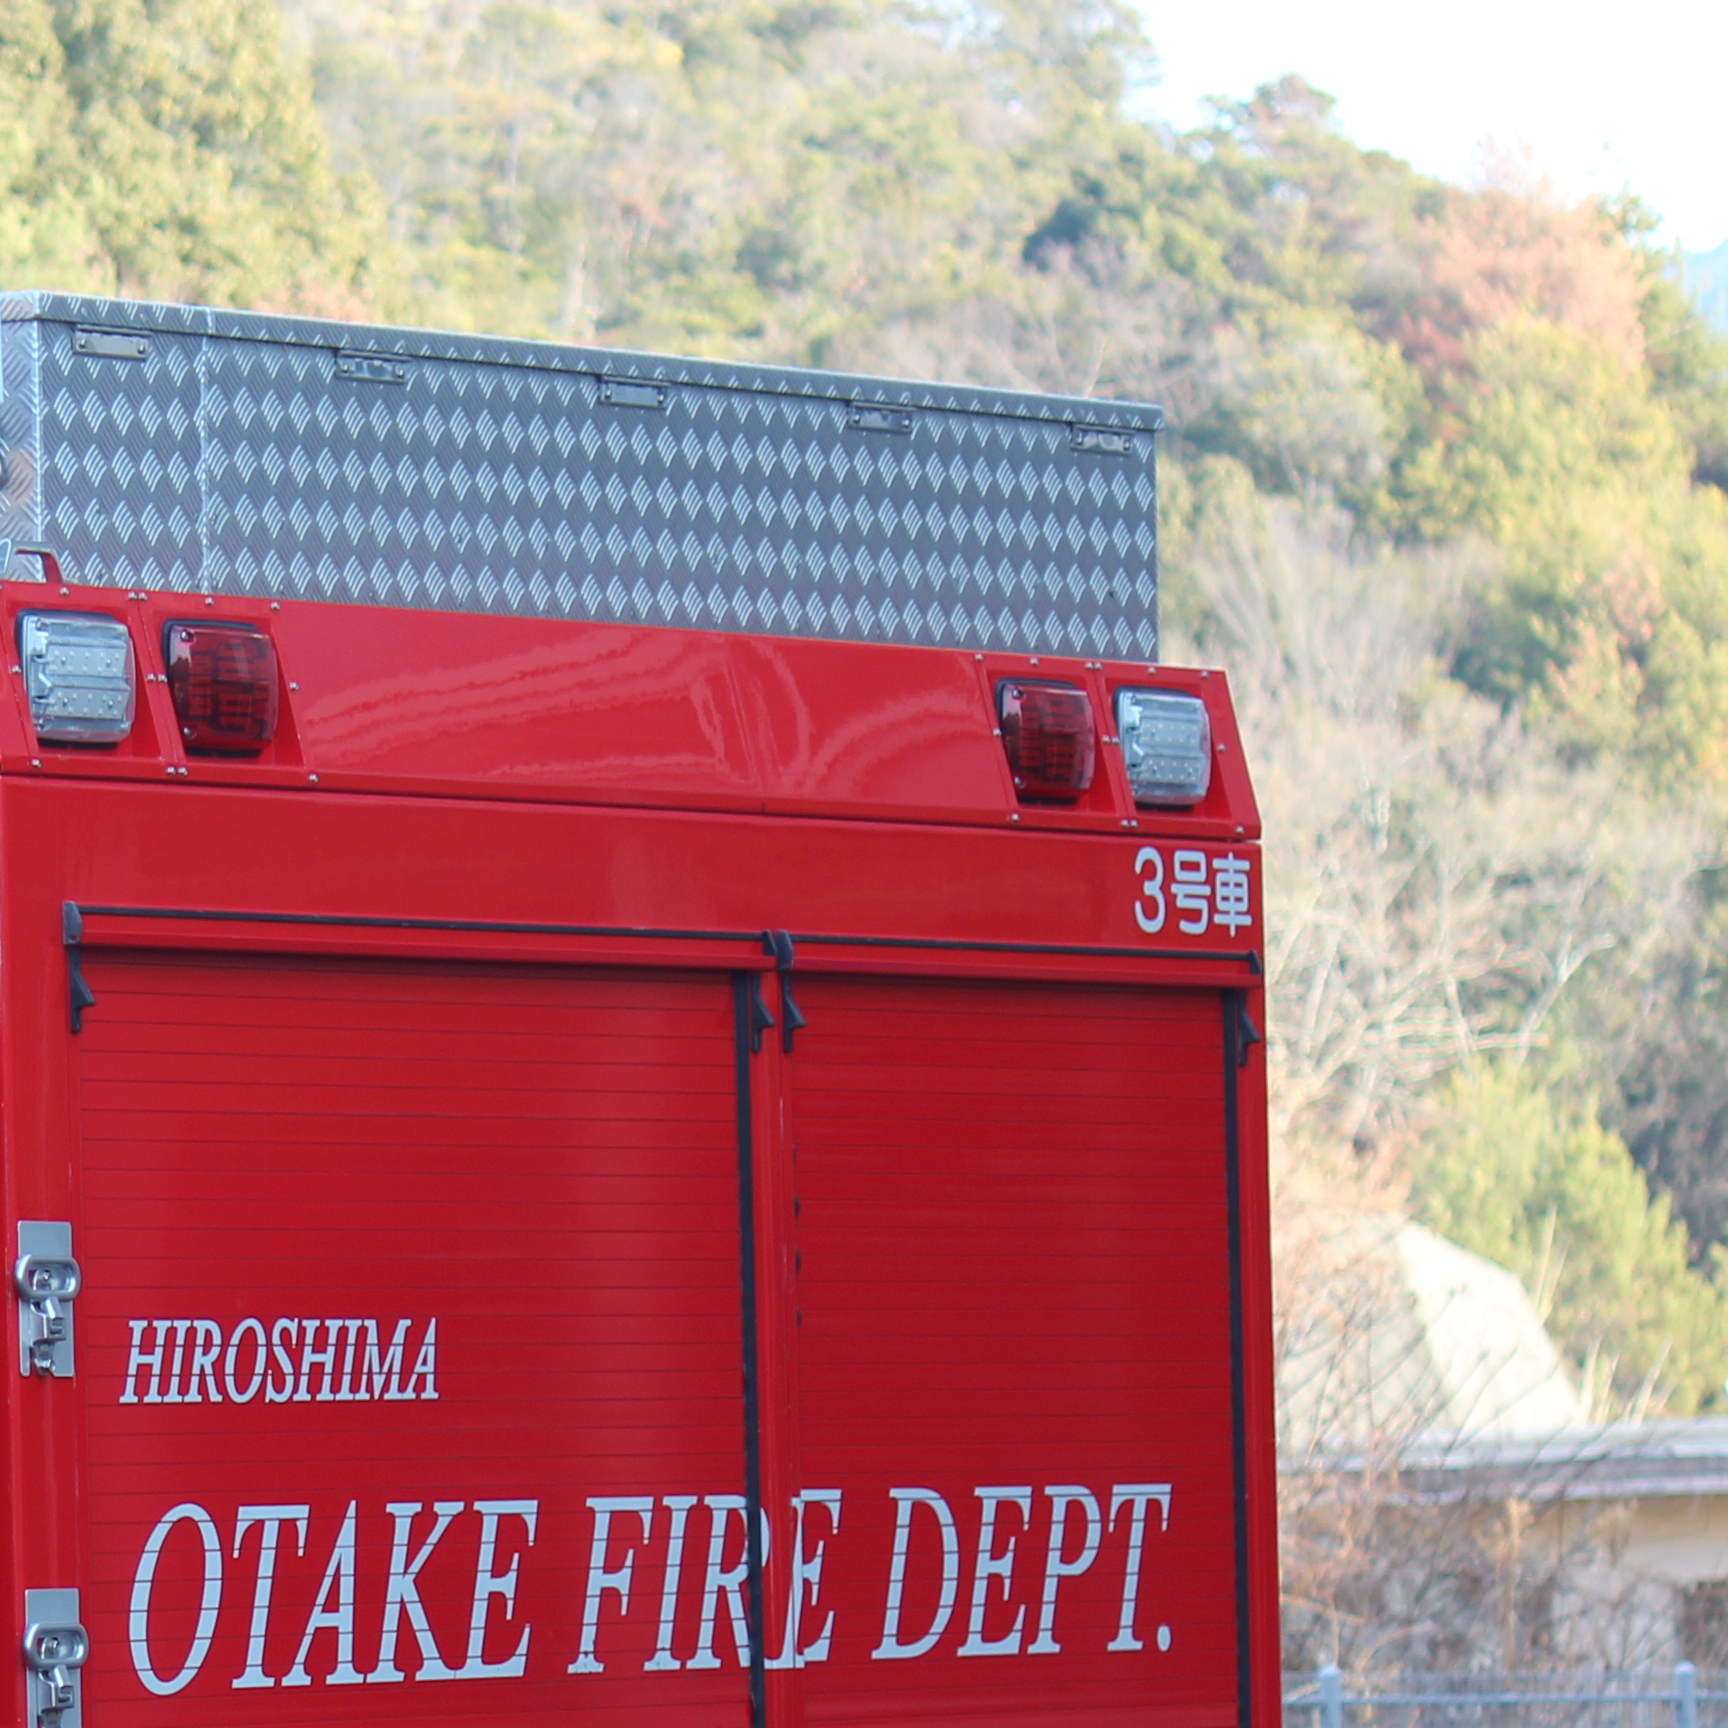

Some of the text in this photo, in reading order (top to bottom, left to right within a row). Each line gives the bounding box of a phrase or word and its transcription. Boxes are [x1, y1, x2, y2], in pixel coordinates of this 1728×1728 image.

[1132, 846, 1253, 937] 3号車
[119, 1316, 440, 1405] HIROSHIMA
[127, 1483, 1172, 1696] OTAKE FIRE DEPT.
